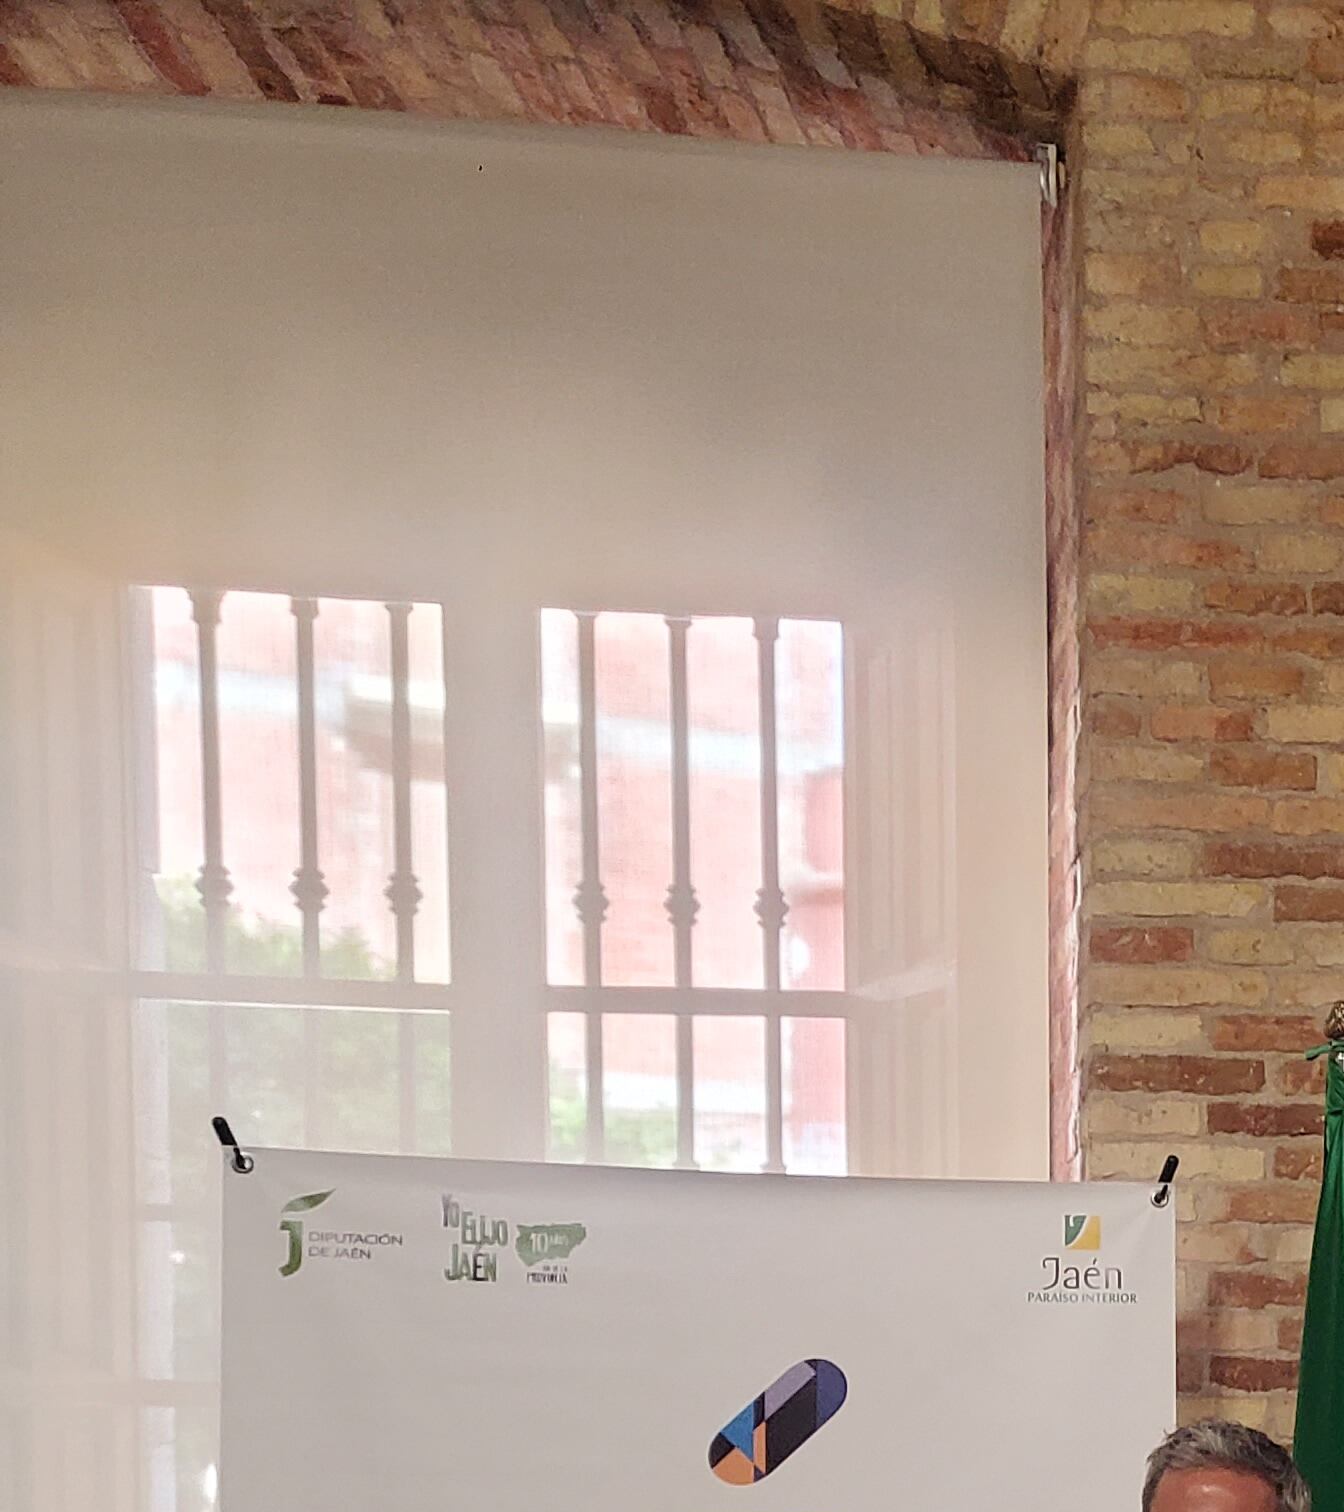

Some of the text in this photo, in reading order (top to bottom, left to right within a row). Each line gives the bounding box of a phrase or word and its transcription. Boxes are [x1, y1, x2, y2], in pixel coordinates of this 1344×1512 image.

[307, 1230, 403, 1246] DIPUTACIÓN
[307, 1246, 371, 1260] DE JAÉN
[1041, 1257, 1122, 1291] Jaén
[1081, 1292, 1138, 1304] INTERIOR
